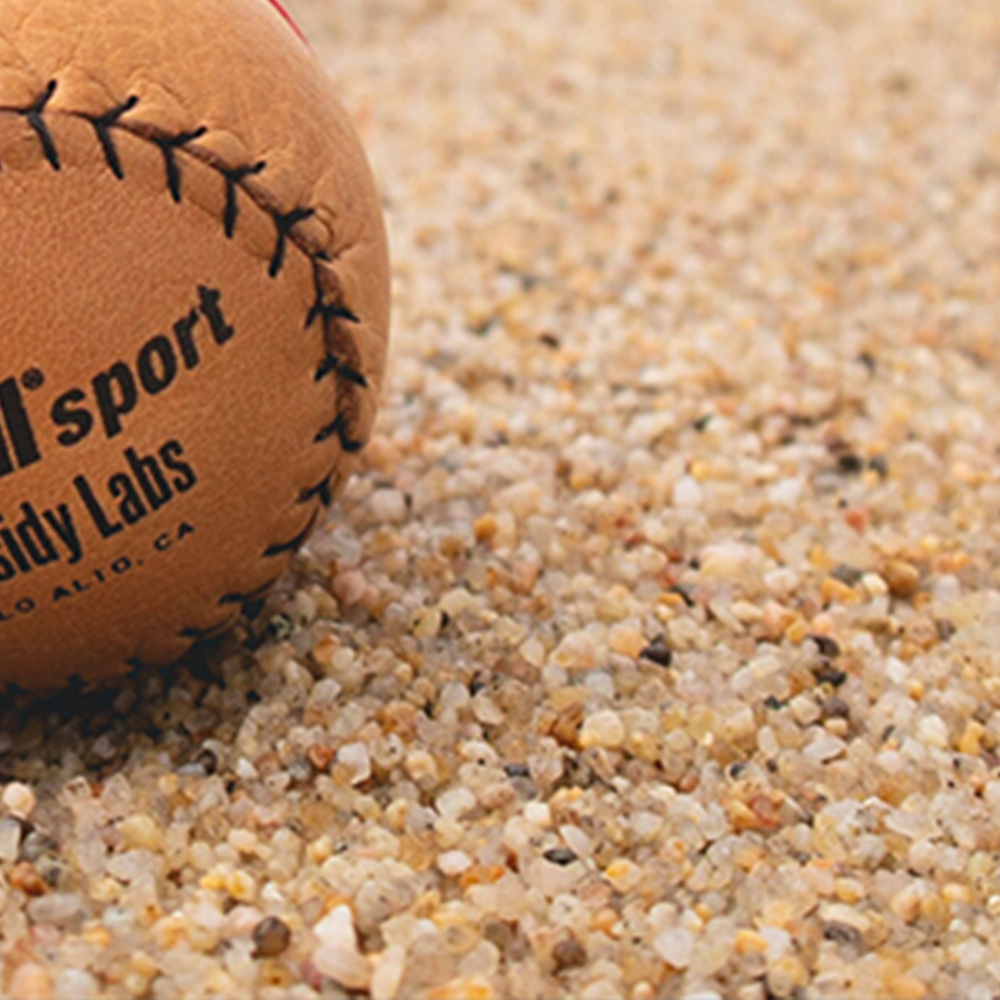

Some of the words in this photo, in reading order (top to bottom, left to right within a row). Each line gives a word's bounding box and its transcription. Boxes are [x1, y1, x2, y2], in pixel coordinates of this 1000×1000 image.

[49, 284, 234, 446] sport
[73, 439, 197, 539] Labs
[153, 521, 195, 552] CA
